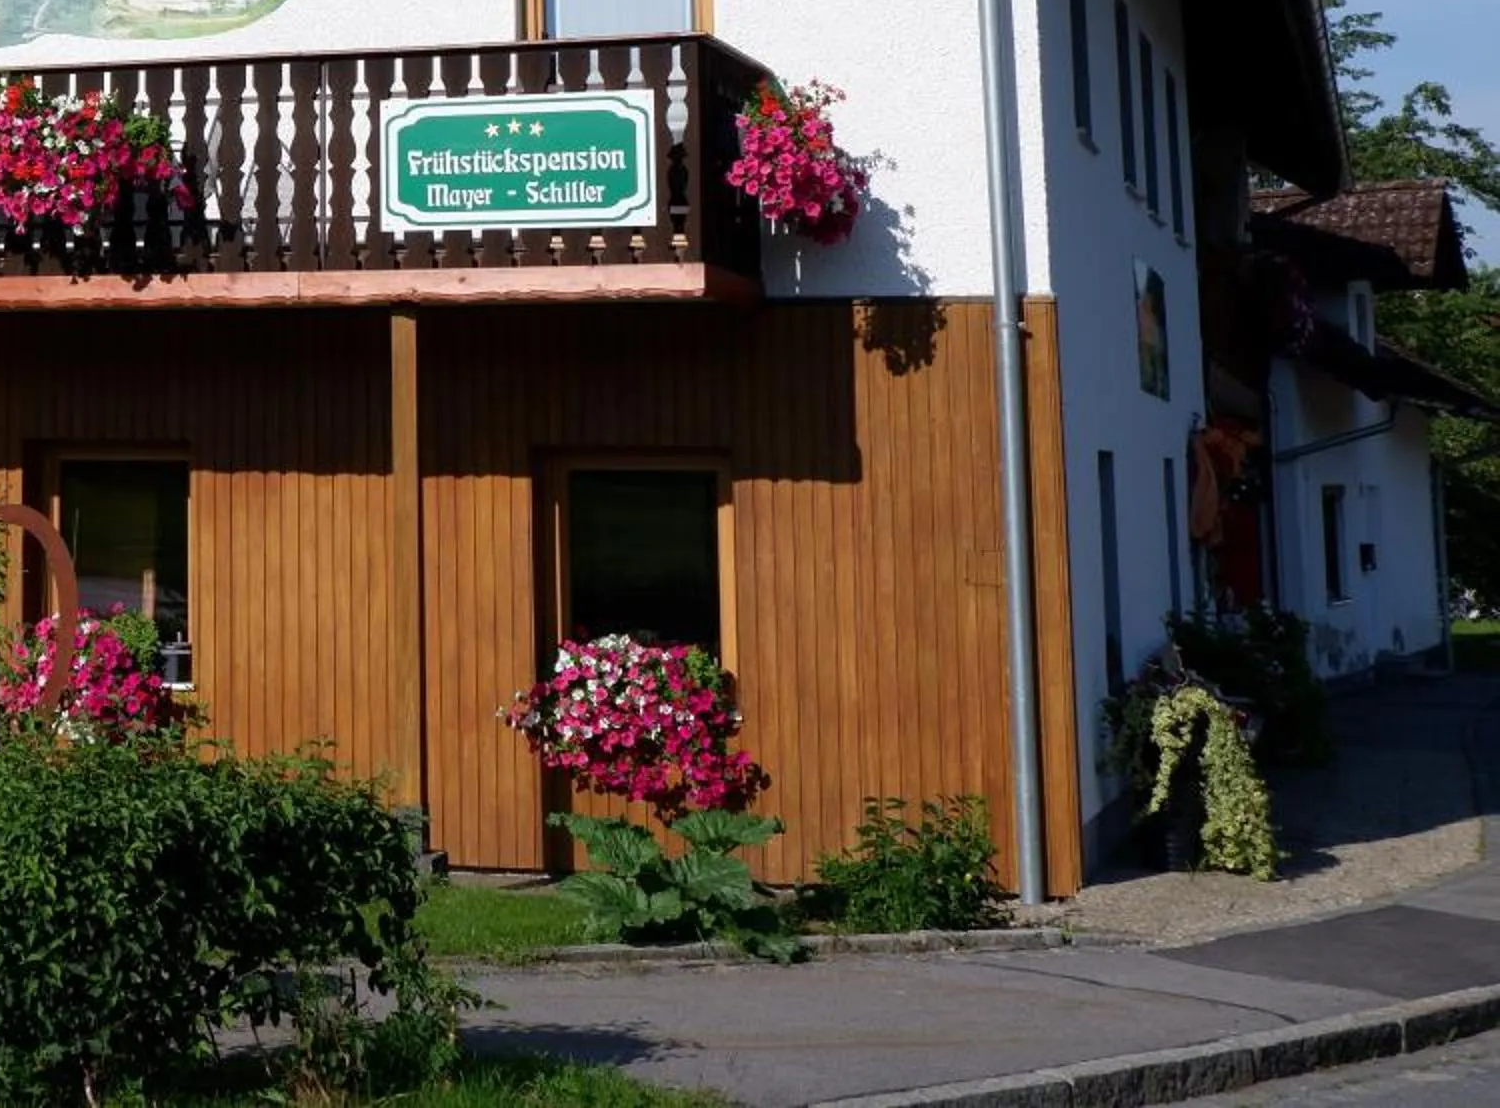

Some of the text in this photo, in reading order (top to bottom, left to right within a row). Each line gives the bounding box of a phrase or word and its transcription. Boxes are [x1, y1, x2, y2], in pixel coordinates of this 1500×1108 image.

[407, 146, 626, 177] Frühstückspension
[426, 183, 493, 210] Mayer
[525, 180, 606, 205] Schiller
